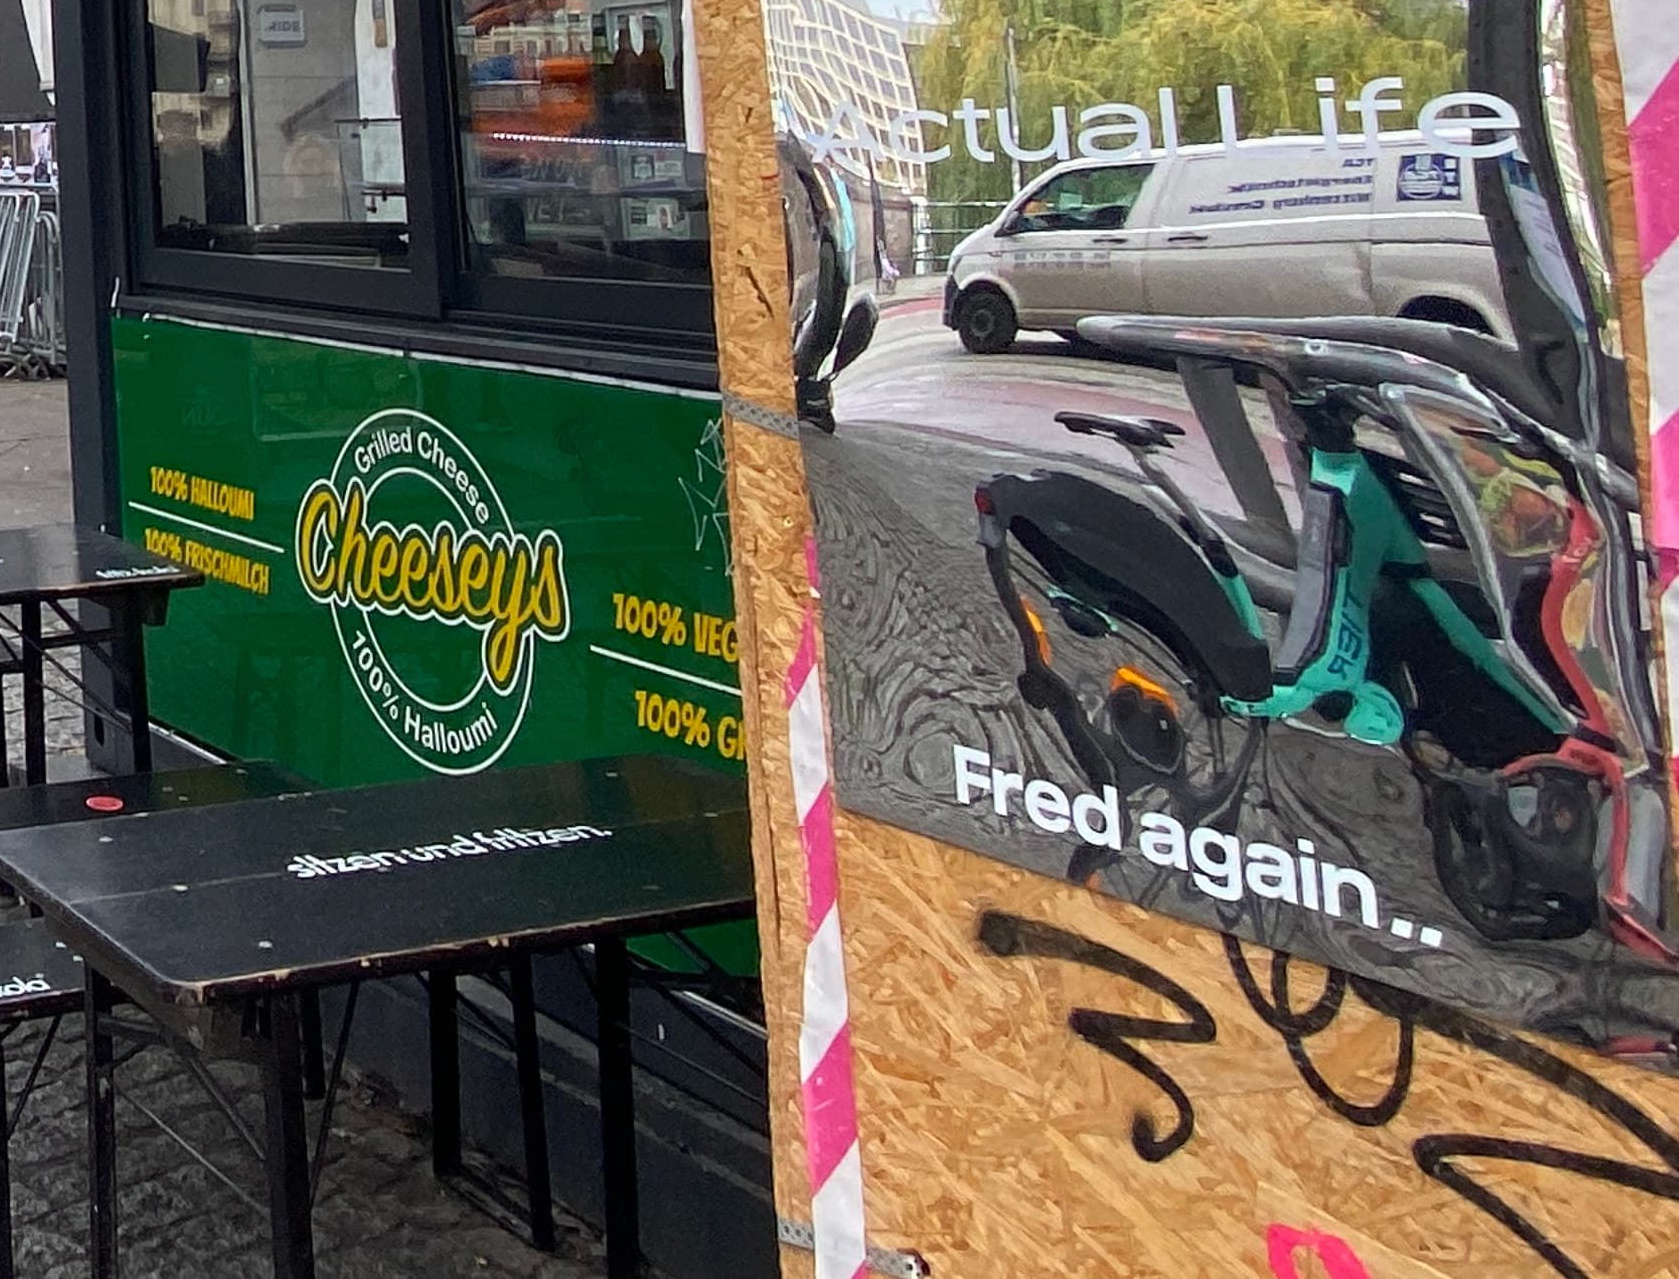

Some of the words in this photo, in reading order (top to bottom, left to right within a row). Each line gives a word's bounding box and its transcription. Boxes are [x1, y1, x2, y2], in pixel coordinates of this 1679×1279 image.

[810, 86, 1178, 166] Actual
[1218, 76, 1522, 159] Life
[150, 466, 188, 501] 100%
[190, 475, 254, 520] HALLOUMI
[354, 426, 412, 473] Grilled
[417, 430, 490, 524] Cheese
[145, 527, 182, 562] 100%
[185, 540, 270, 595] FRISCHMILCH
[297, 482, 568, 692] Cheeseys
[612, 593, 687, 646] 100%
[351, 629, 399, 721] 100%
[403, 700, 499, 755] Halloumi
[634, 689, 711, 749] 100%
[952, 743, 1124, 852] Fred
